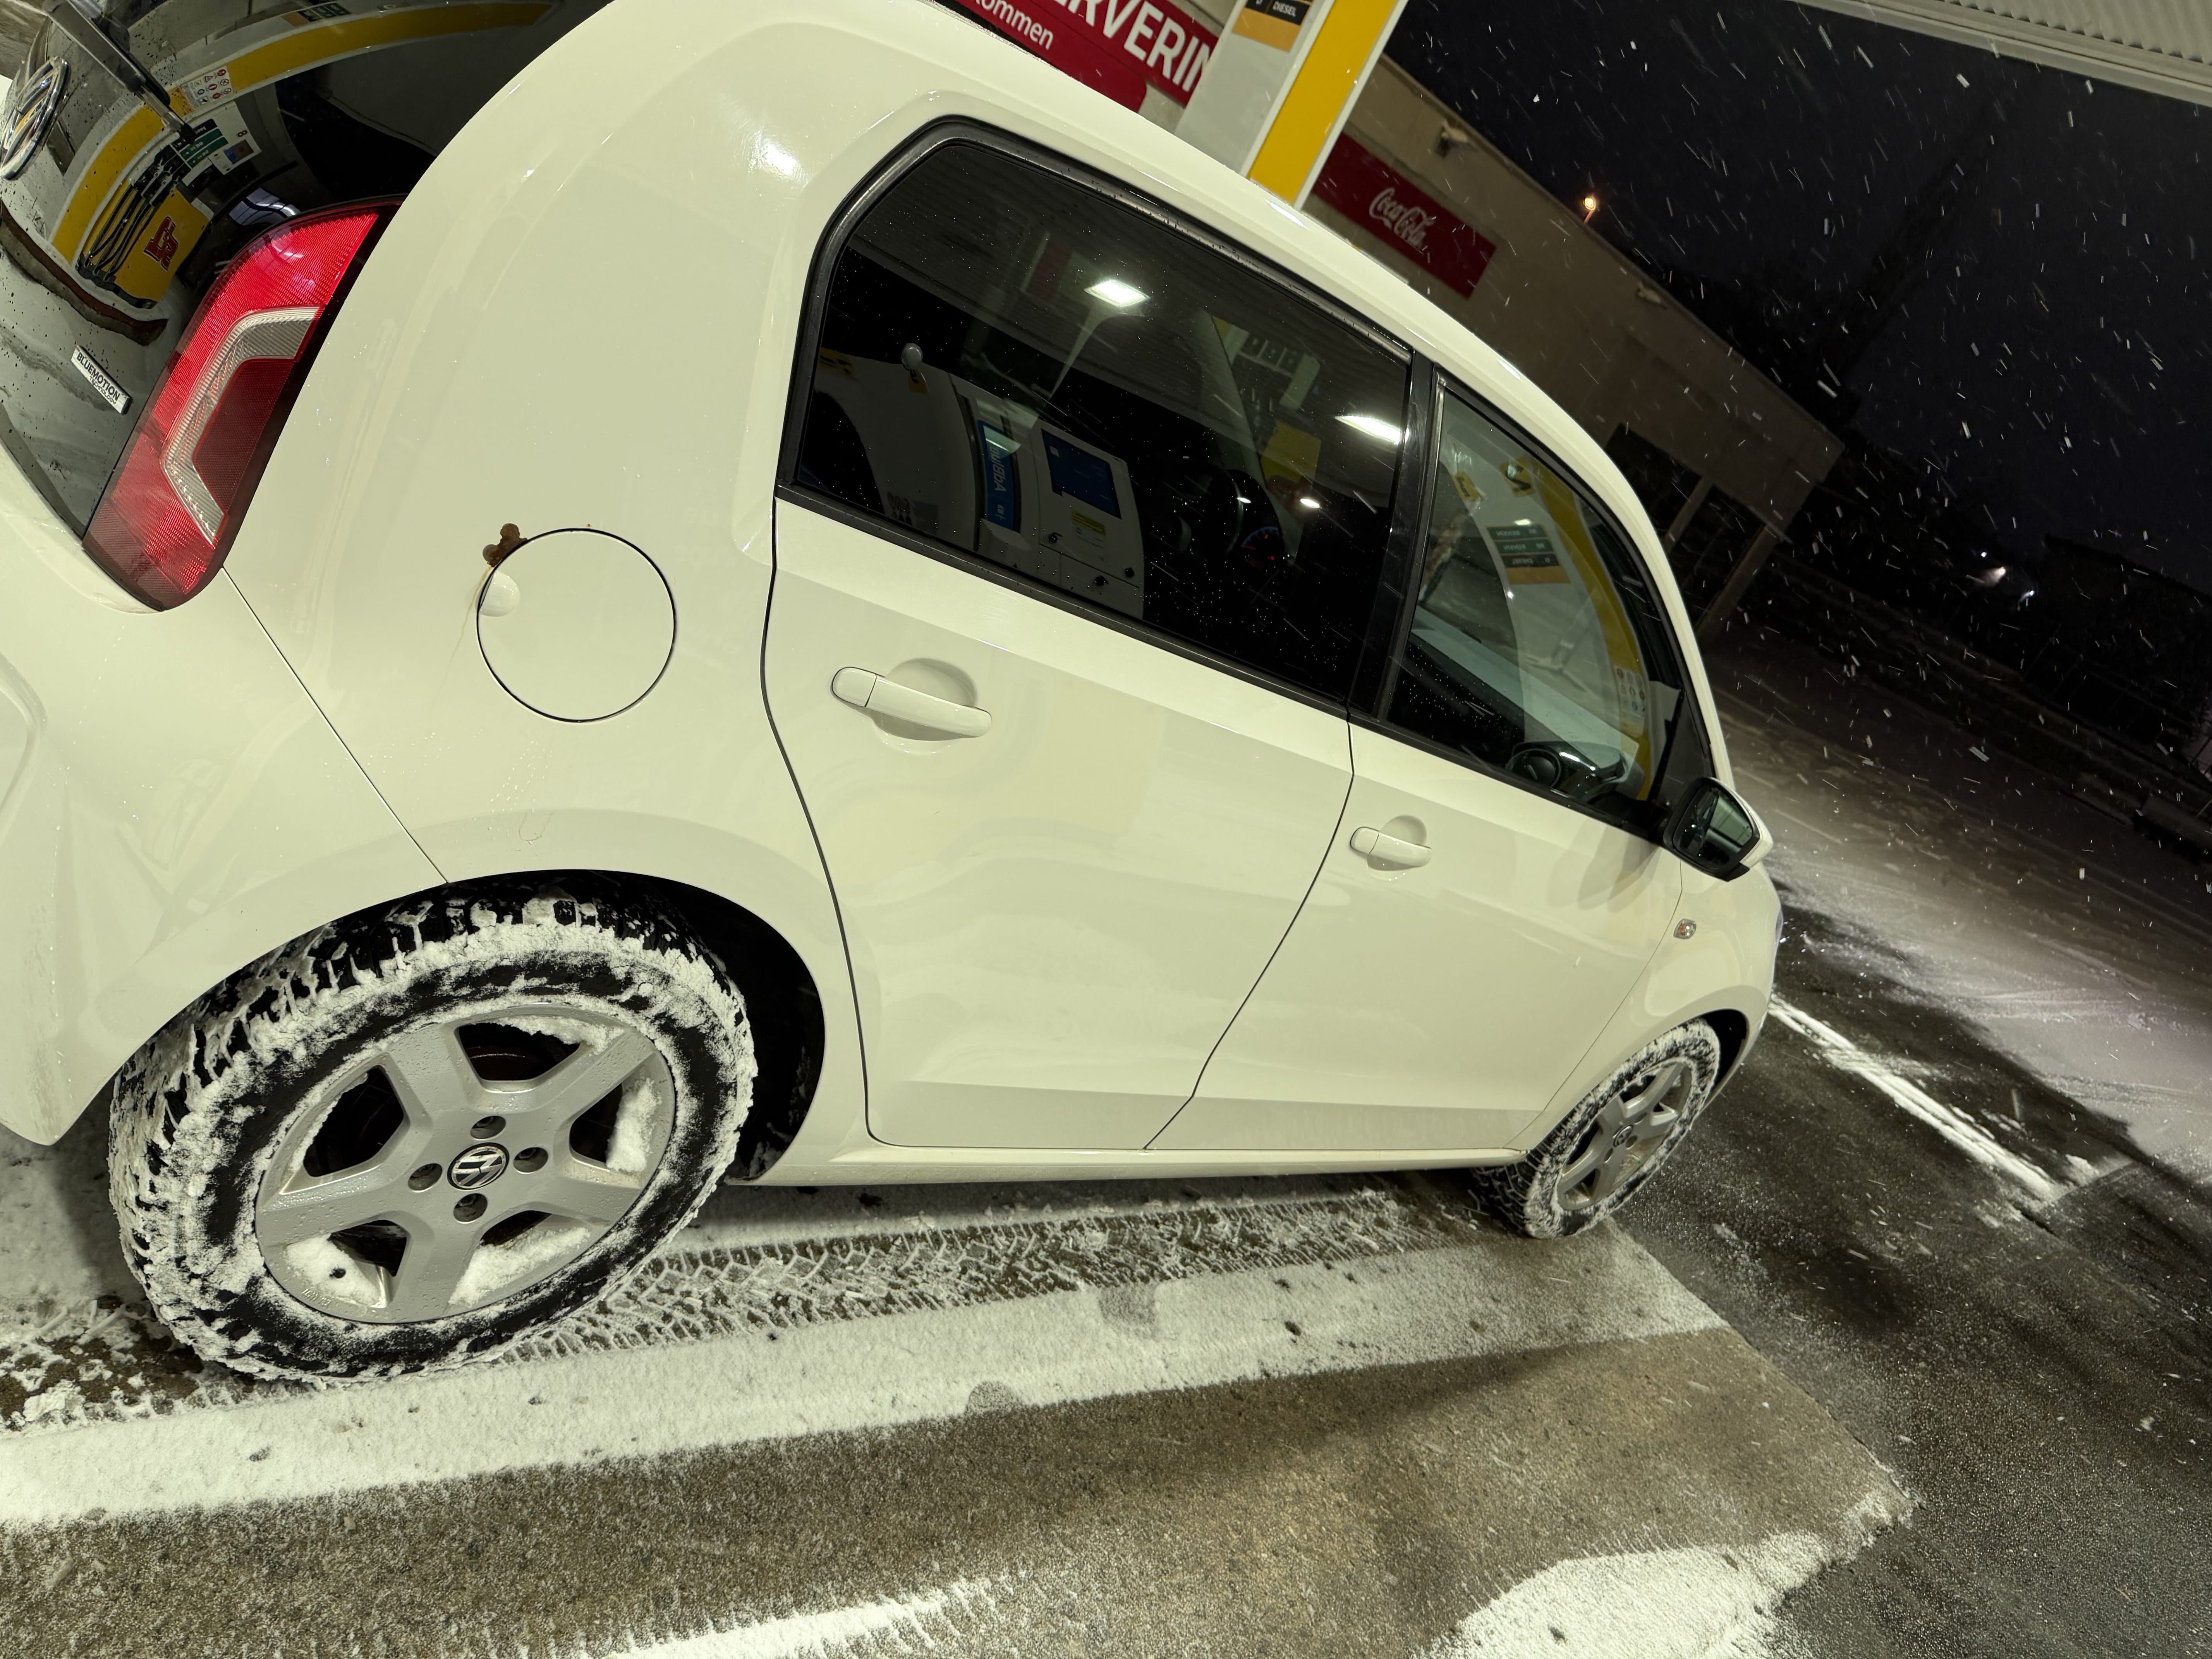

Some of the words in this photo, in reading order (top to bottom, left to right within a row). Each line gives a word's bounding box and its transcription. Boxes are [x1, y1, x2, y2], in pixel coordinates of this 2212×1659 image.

[975, 0, 1053, 50] ommen
[1272, 1, 1297, 17] DIESEL
[77, 352, 120, 402] BLUEMOTION
